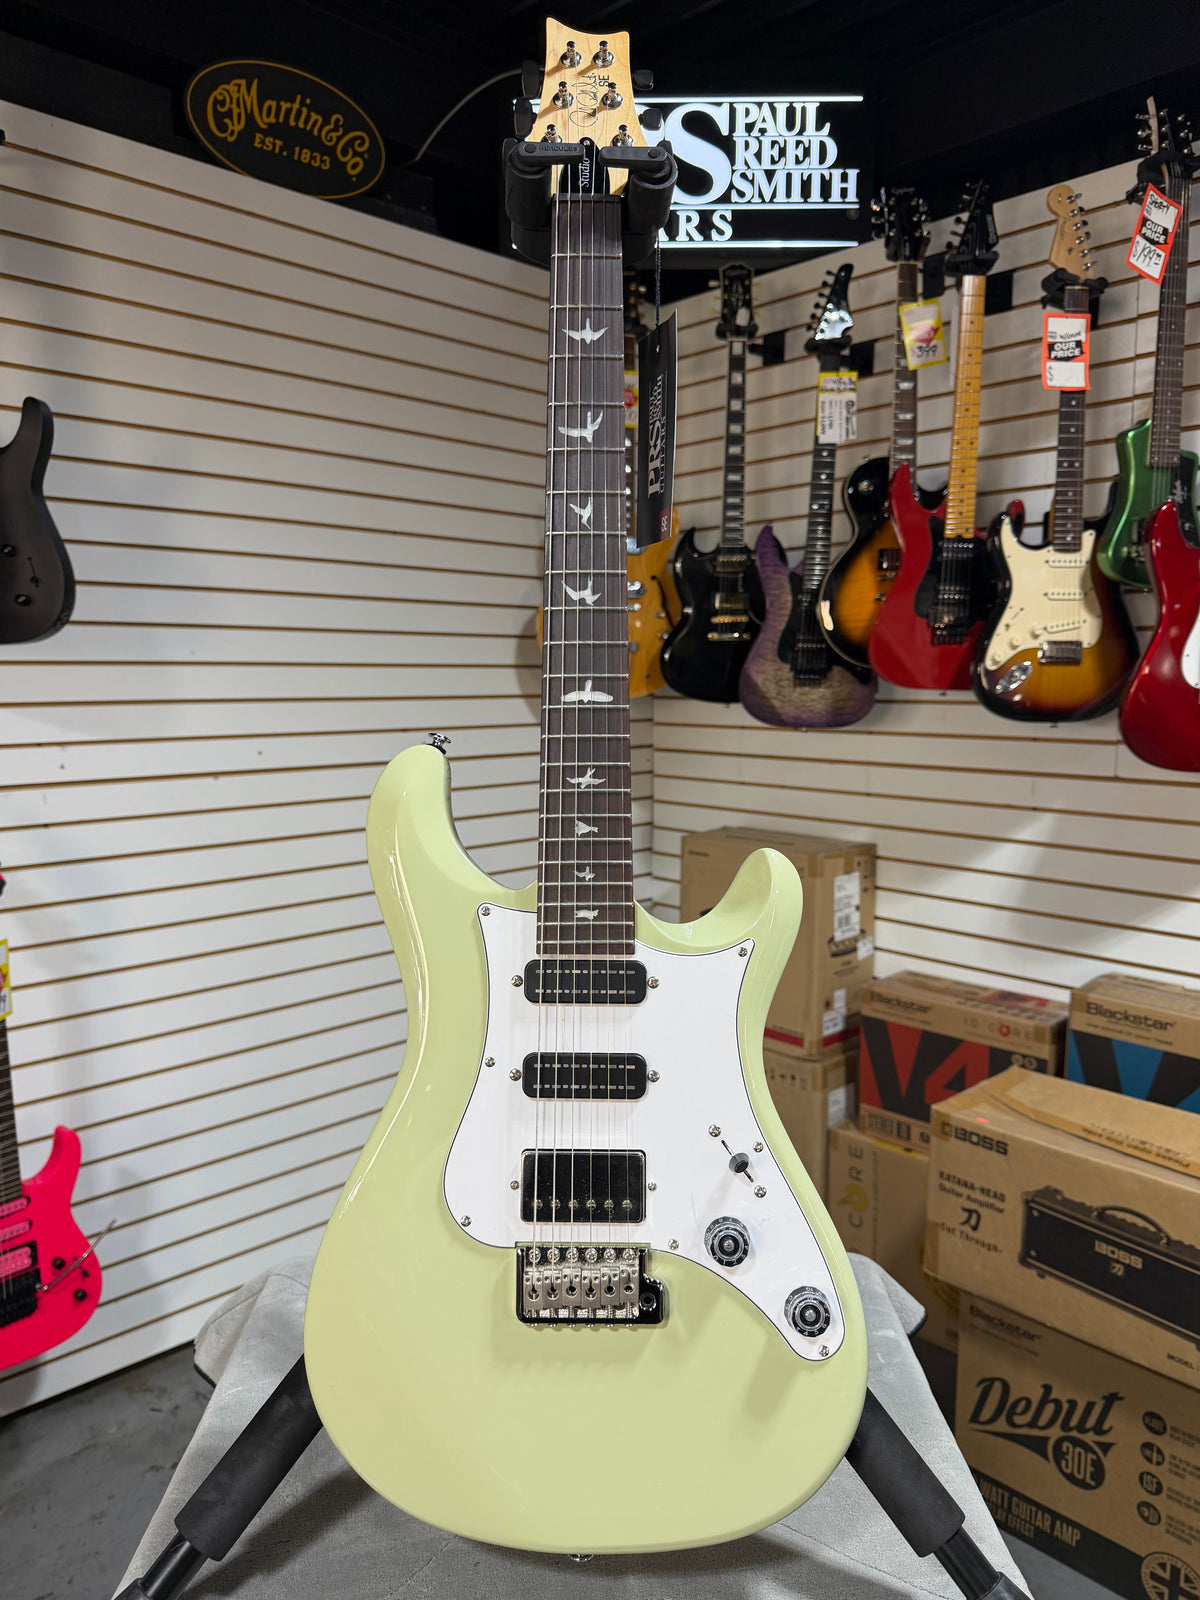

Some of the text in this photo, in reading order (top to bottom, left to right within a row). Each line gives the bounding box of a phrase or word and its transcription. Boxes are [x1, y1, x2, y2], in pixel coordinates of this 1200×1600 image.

[732, 101, 831, 137] PAUL
[254, 133, 330, 170] EST. 1833
[732, 135, 838, 170] REED
[579, 158, 590, 188] Studio
[731, 168, 861, 203] SMITH
[1141, 228, 1167, 244] PRICE
[1145, 220, 1164, 233] OUR
[1050, 348, 1082, 359] PRICE
[1053, 341, 1076, 351] OUR
[647, 419, 661, 499] PRS
[658, 416, 667, 494] GUITARS
[870, 990, 932, 1014] Blackstar
[1086, 1002, 1175, 1031] Blackstar
[954, 1126, 1009, 1156] BOSS
[1094, 1240, 1144, 1270] BOSS
[969, 1304, 1041, 1341] Blackstar
[1166, 1352, 1196, 1370] MODEL
[968, 1376, 1125, 1437] Debut
[1059, 1440, 1098, 1488] 30E
[1011, 1496, 1051, 1534] GUITAR
[1053, 1520, 1081, 1547] AMP
